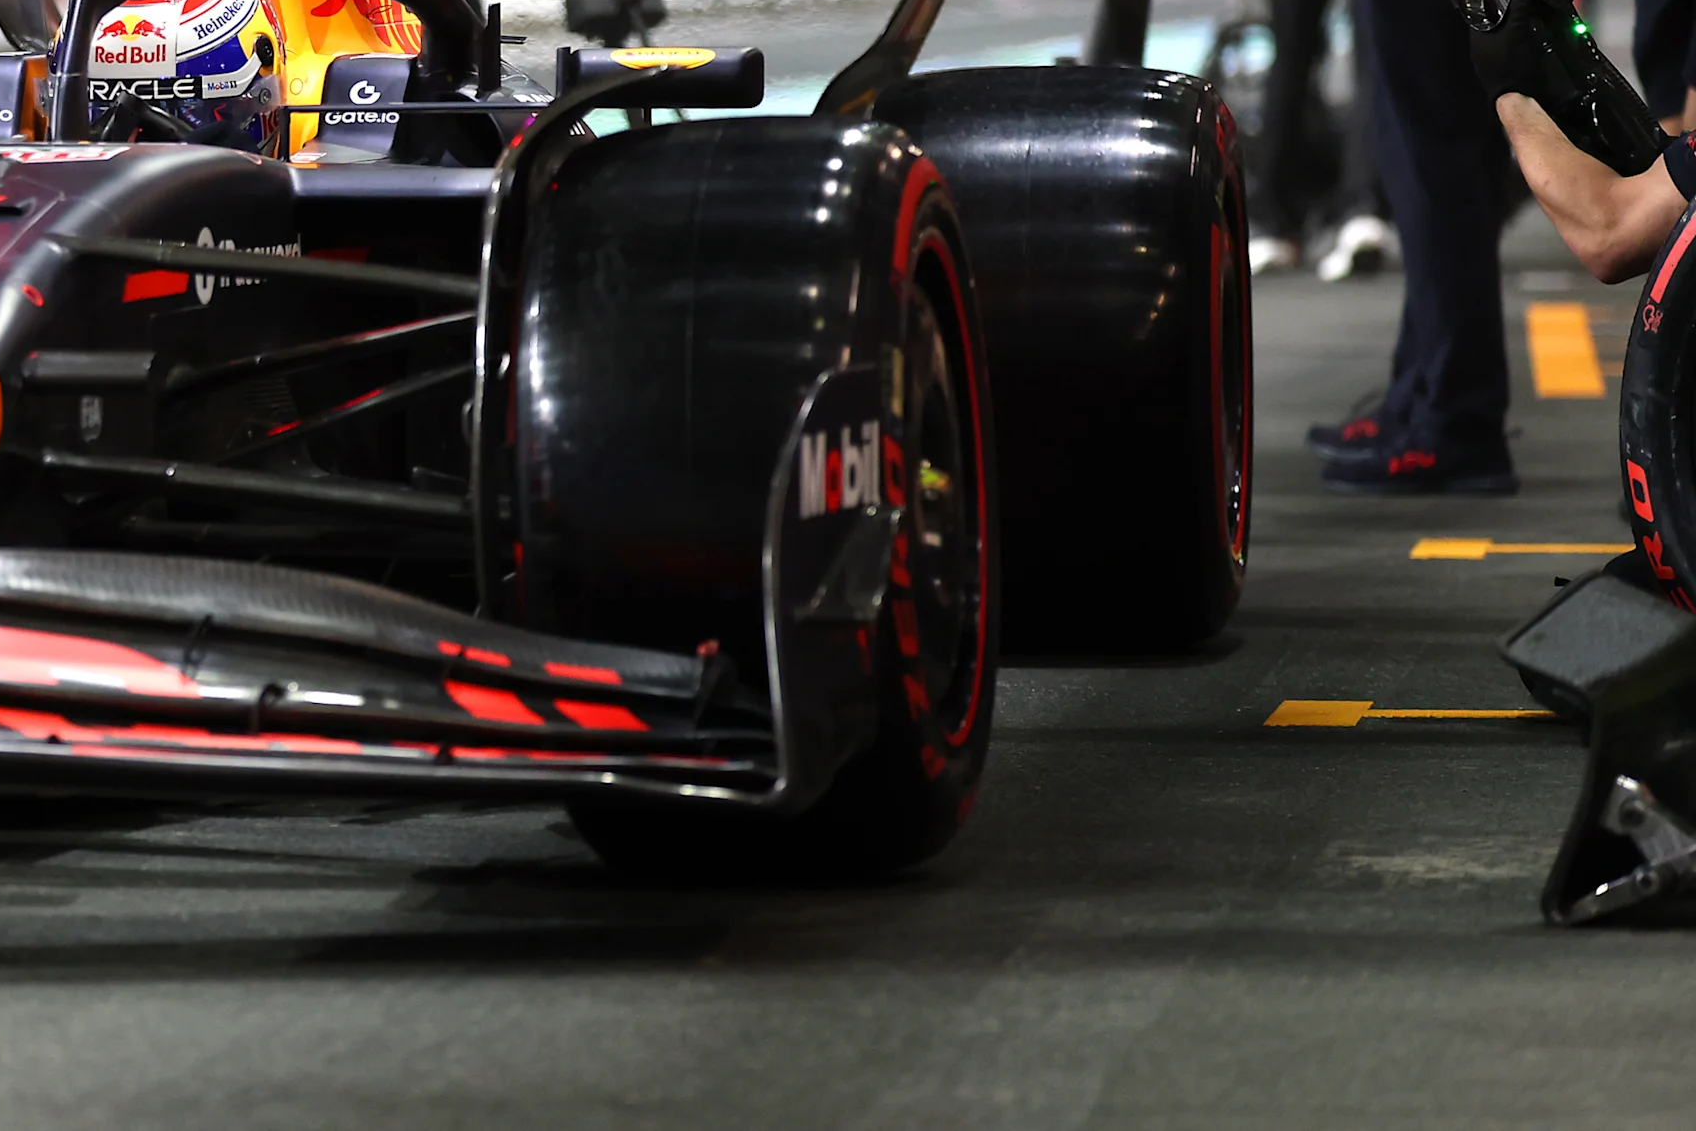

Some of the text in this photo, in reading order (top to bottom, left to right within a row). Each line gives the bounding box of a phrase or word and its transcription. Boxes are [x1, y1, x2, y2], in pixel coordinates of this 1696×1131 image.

[95, 44, 166, 64] Red Bull
[89, 78, 196, 101] RACLE
[207, 81, 230, 91] Mobil
[799, 420, 881, 519] Mobil
